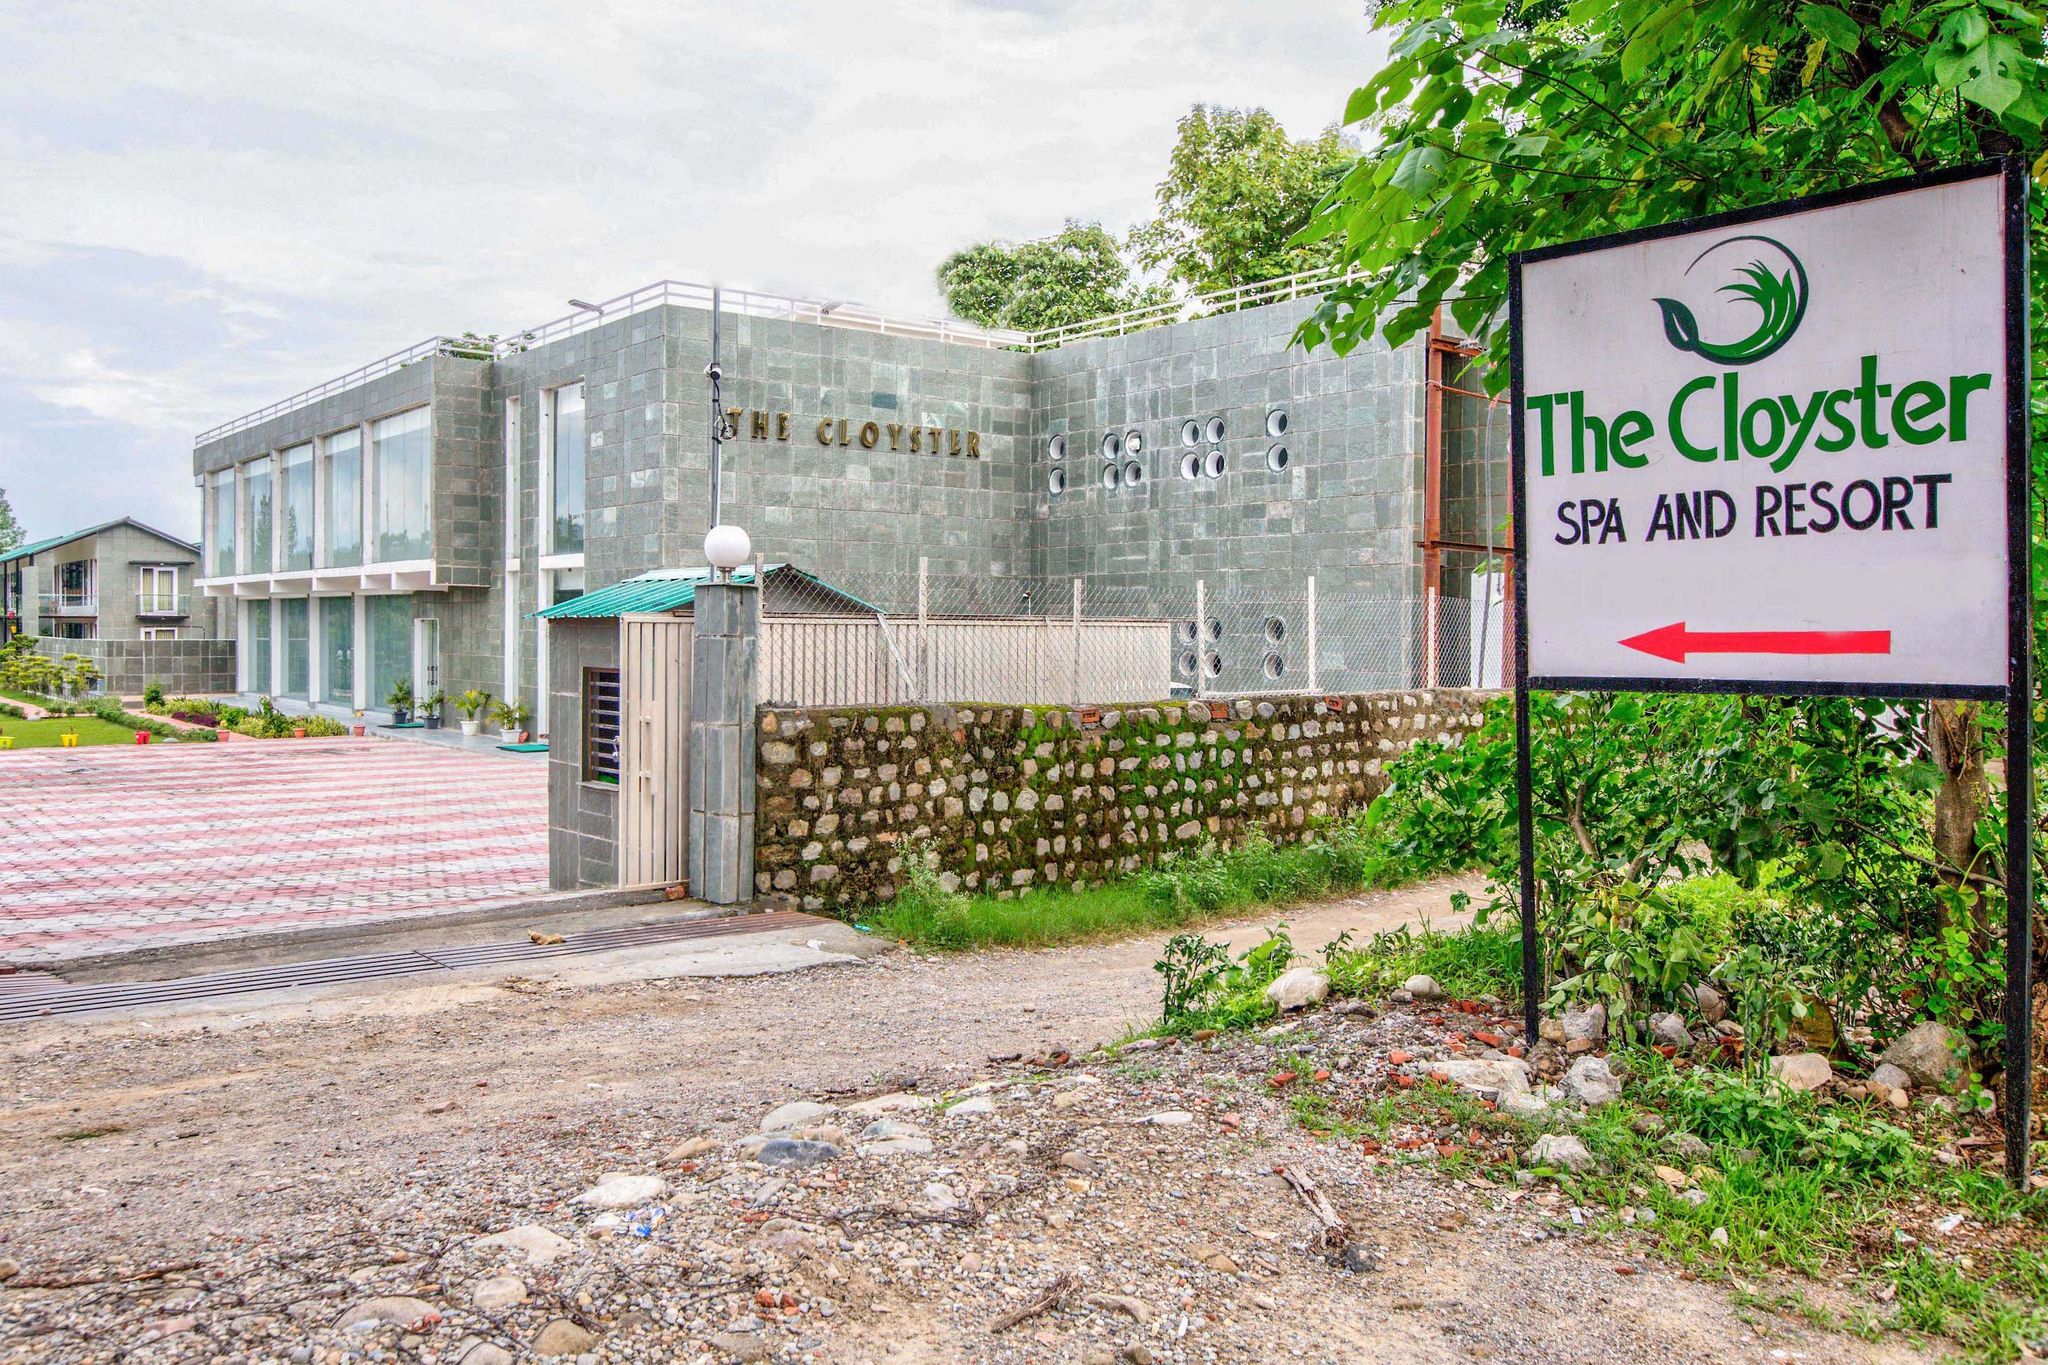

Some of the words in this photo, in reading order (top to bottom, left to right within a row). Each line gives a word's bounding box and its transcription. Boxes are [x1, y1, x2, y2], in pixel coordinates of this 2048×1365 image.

[726, 407, 791, 441] THE
[816, 416, 982, 457] CLOYSTER
[1526, 389, 1655, 477] The
[1667, 354, 1992, 473] Cloyster
[1554, 497, 1627, 546] SPA
[1645, 489, 1737, 543] AND
[1755, 473, 1952, 538] RESORT
